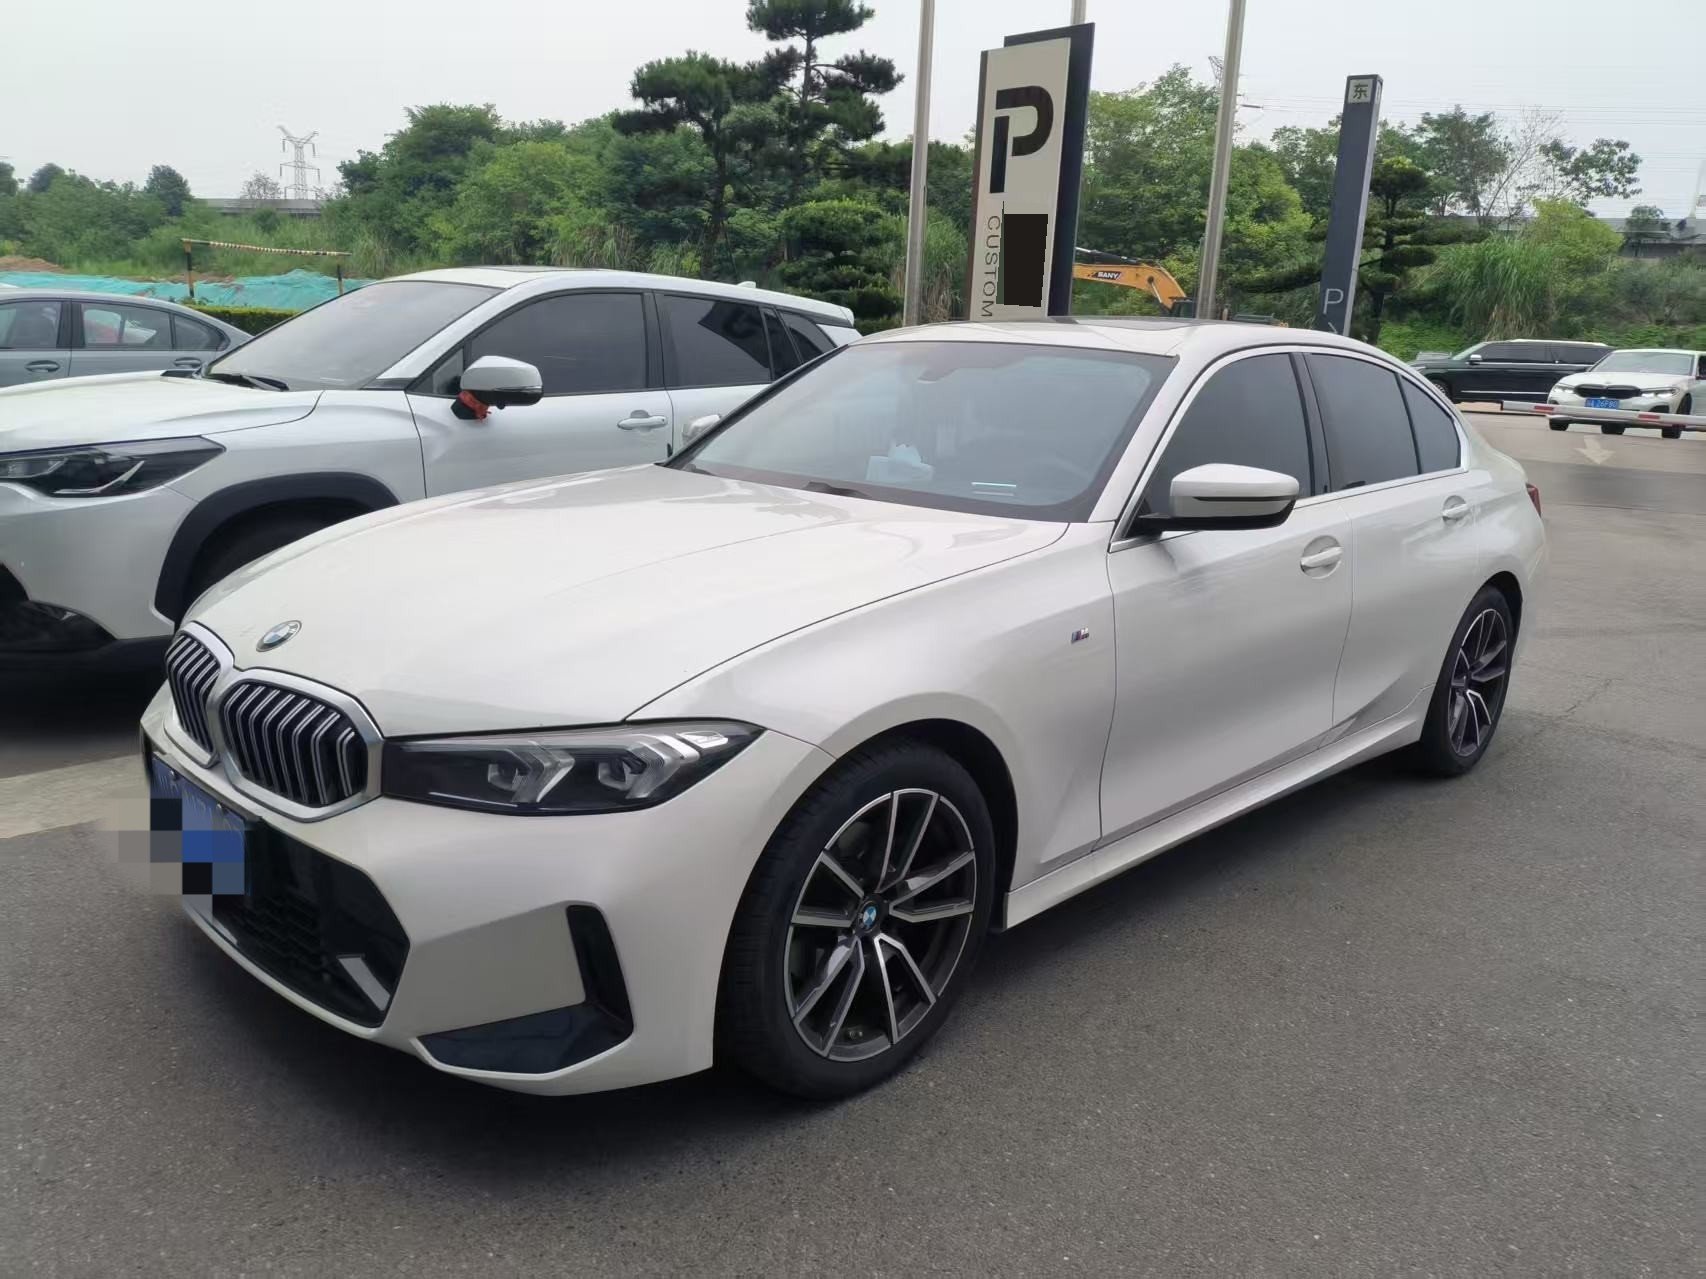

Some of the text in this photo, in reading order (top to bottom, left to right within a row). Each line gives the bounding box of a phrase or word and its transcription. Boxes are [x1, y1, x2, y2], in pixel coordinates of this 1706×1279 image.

[1353, 83, 1369, 100] 东
[990, 86, 1054, 193] P
[1323, 288, 1344, 315] P
